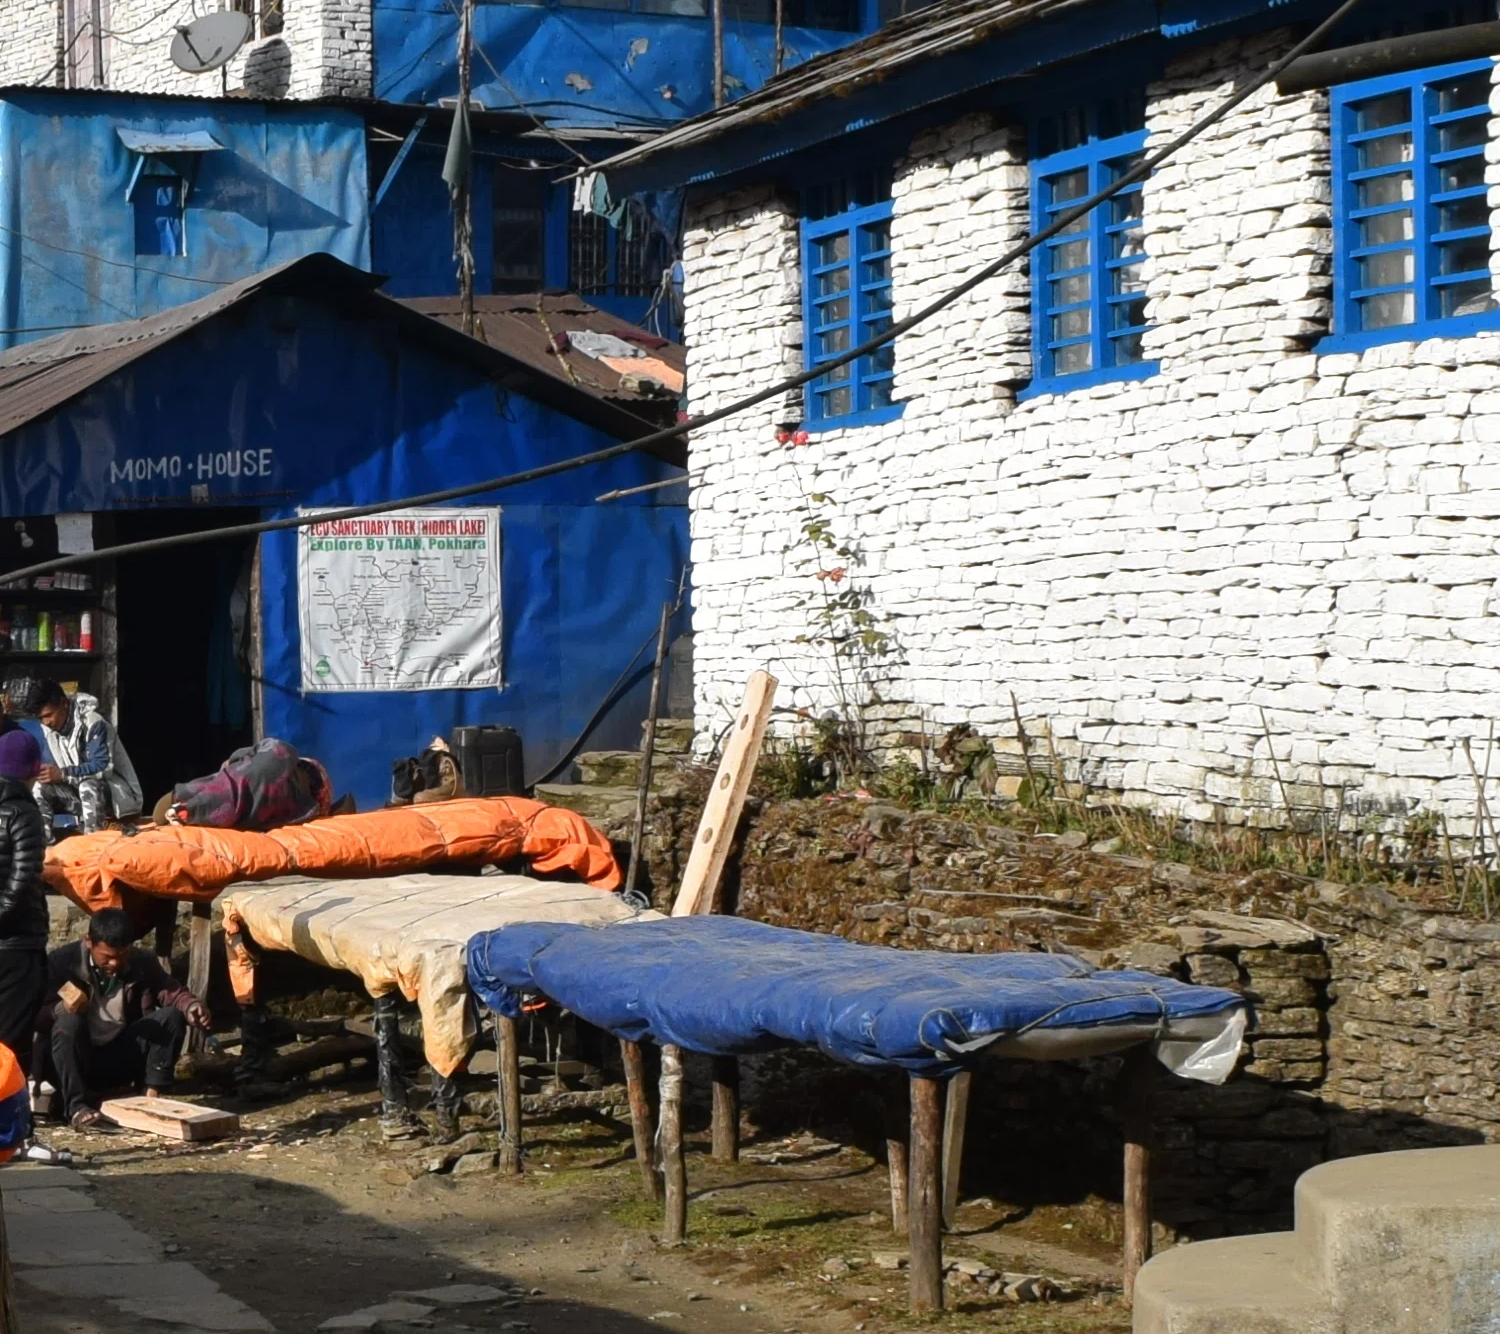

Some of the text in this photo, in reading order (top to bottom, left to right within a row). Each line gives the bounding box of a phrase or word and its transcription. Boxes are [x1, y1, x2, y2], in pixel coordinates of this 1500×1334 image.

[110, 448, 273, 484] MOMO HOUSE
[331, 519, 389, 536] SANCTUARY
[391, 519, 416, 536] TREK
[310, 538, 362, 552] Explore
[366, 538, 384, 553] By
[429, 538, 486, 551] Pokhara
